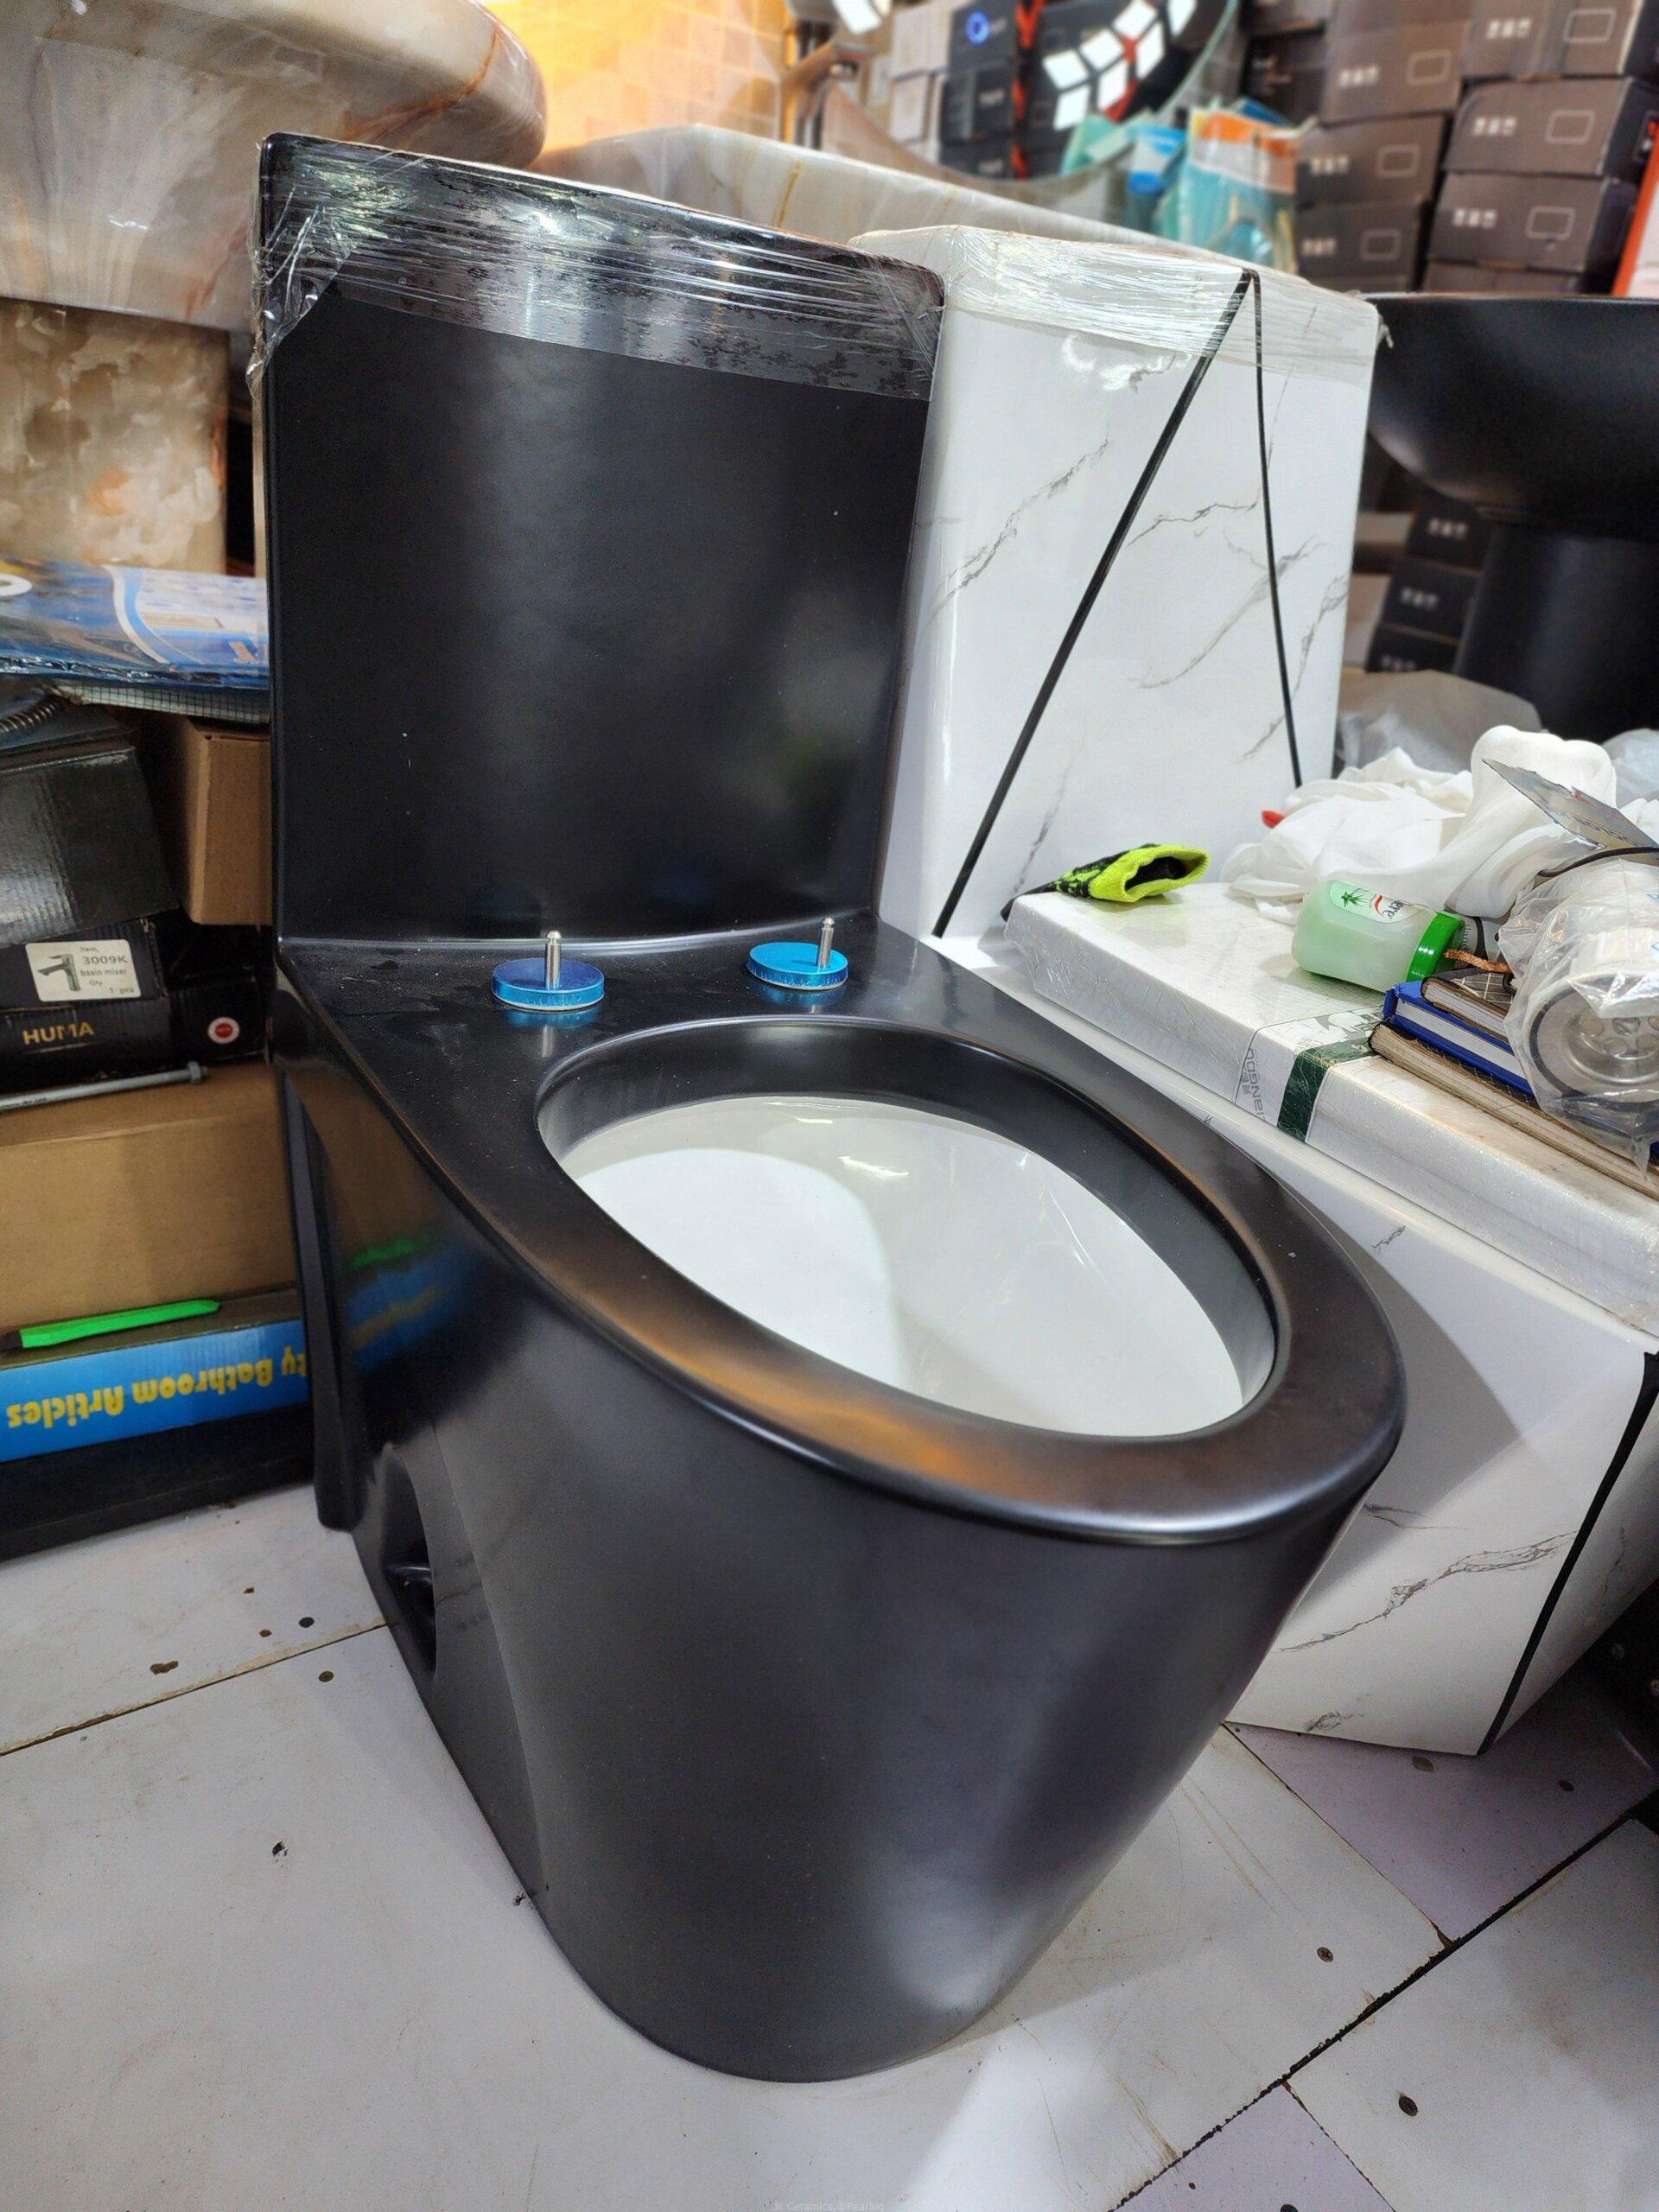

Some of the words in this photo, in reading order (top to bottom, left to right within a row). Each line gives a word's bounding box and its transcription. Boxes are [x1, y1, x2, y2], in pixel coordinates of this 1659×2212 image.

[83, 955, 128, 965] 3009K
[132, 1358, 273, 1404] Bathroom
[6, 1385, 124, 1428] Articles
